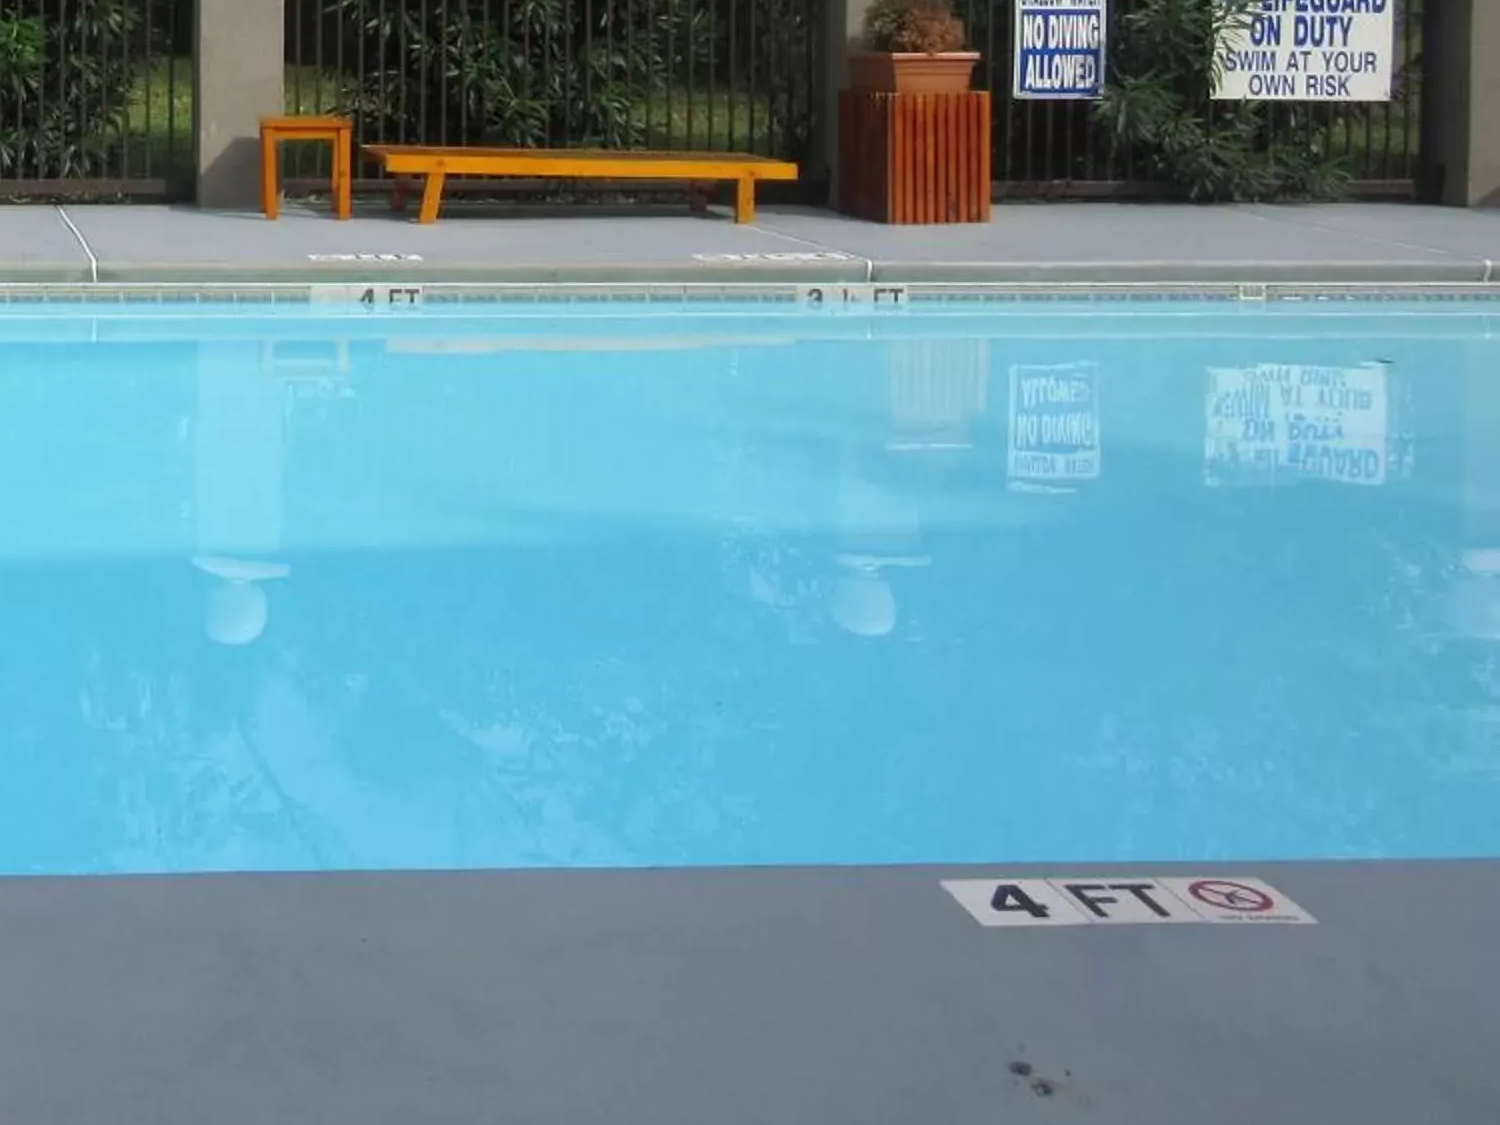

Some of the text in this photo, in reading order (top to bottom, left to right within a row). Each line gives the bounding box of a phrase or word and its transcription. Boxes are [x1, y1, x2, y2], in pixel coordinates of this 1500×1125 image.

[1023, 15, 1099, 50] NO DIVING
[1251, 15, 1353, 47] ON DUTY
[1025, 55, 1096, 89] ALLOWED
[1225, 50, 1377, 73] SWIM AT YOUR
[1249, 74, 1351, 96] OWN RISK
[389, 288, 420, 304] FT
[991, 884, 1171, 918] 4 FT
